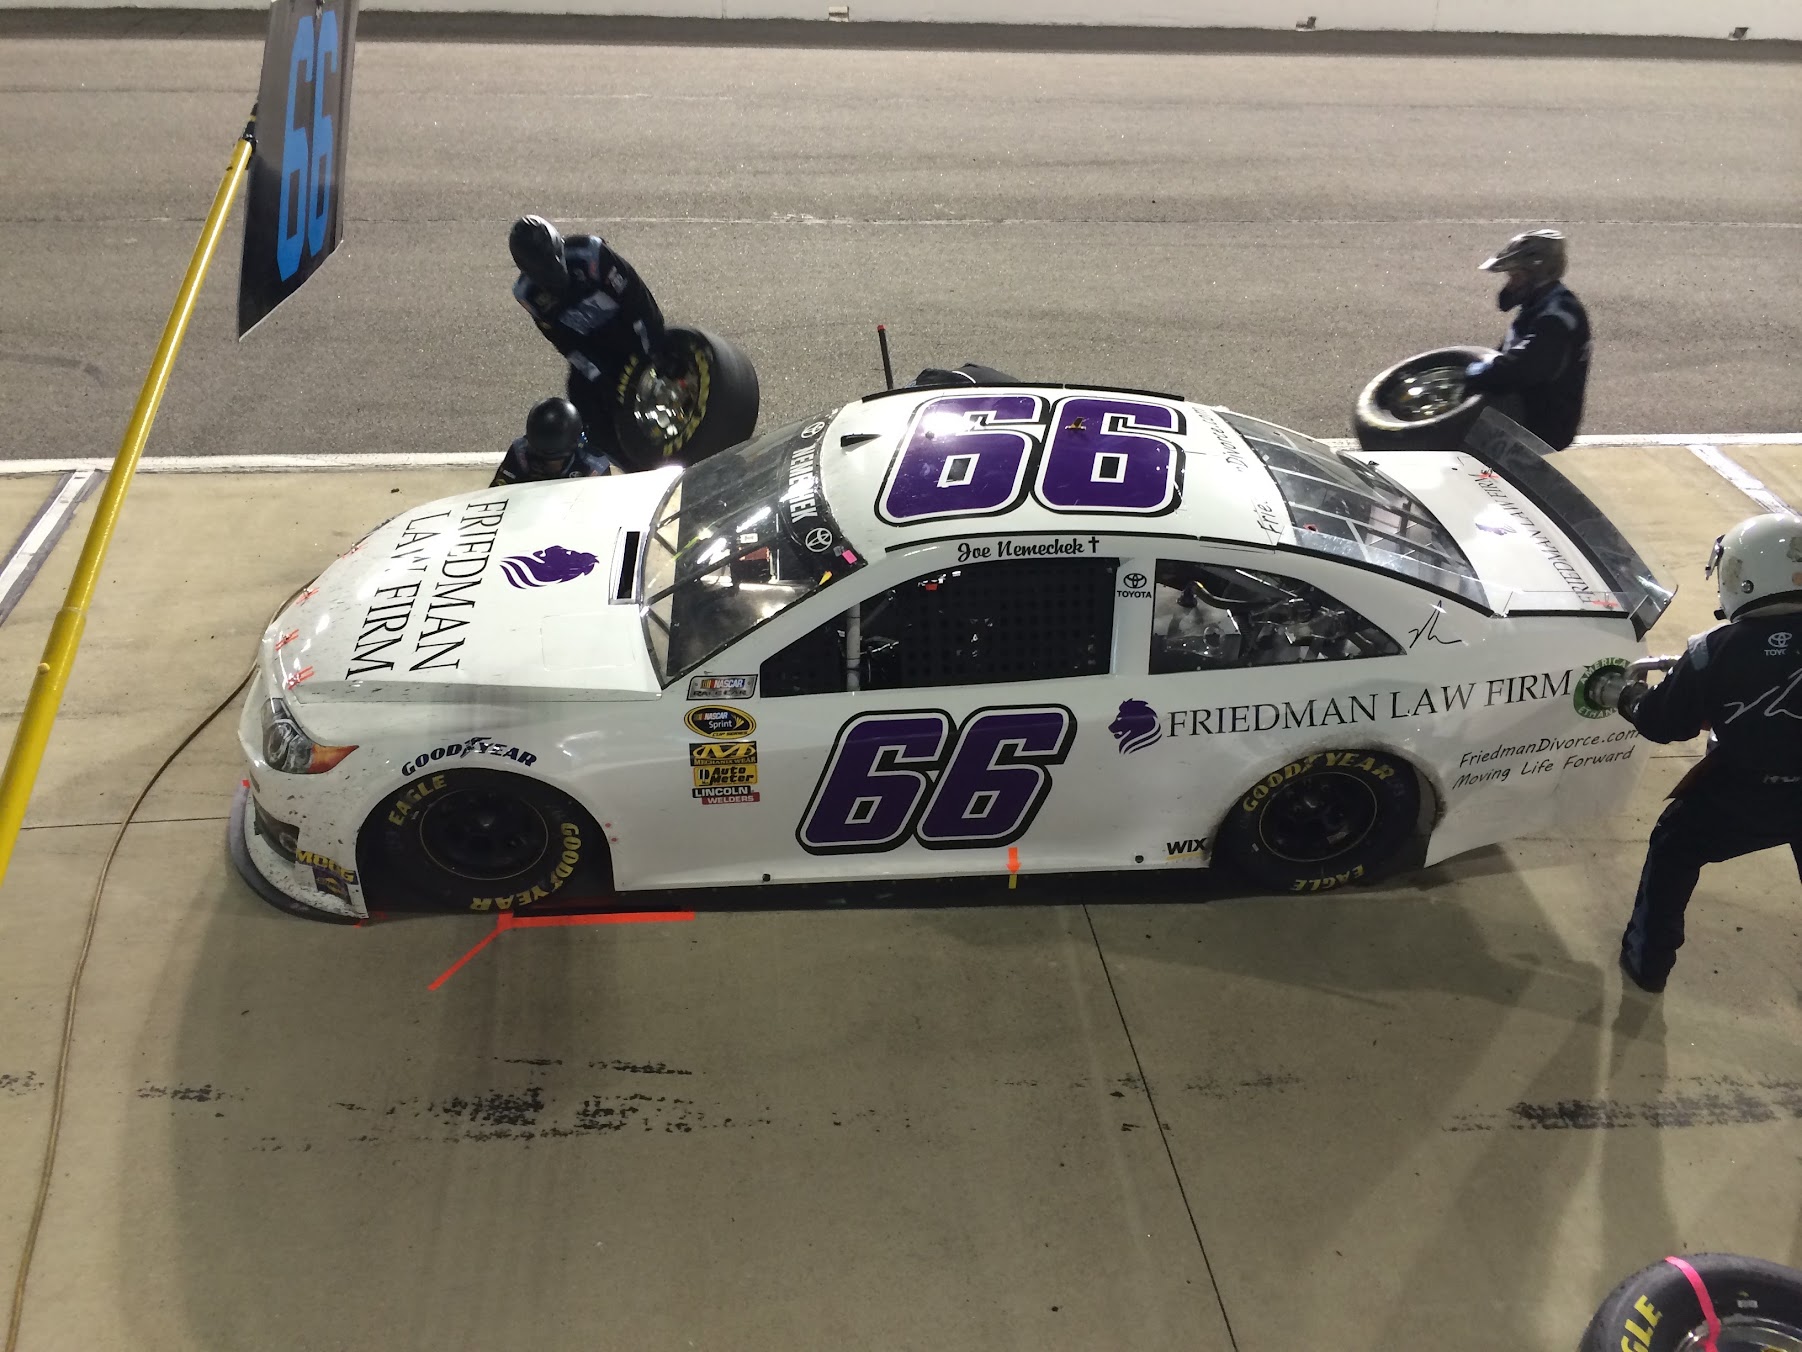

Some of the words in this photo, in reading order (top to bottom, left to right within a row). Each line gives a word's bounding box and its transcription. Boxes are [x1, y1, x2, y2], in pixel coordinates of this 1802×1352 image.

[277, 10, 339, 283] 66
[874, 393, 1187, 528] 66
[788, 443, 818, 524] NEMEHEK
[957, 541, 992, 562] Joe
[998, 537, 1085, 557] Nemechek
[409, 499, 509, 671] FRIEDMAN
[1116, 590, 1152, 599] TOYOTA
[346, 580, 421, 680] FIRM
[713, 679, 744, 689] NASCAR
[1580, 657, 1628, 684] AMERICA
[704, 712, 729, 720] NASCAR
[1166, 693, 1379, 737] FRIEDMAN
[1390, 683, 1477, 719] LAW
[1483, 669, 1574, 707] FIRM
[1578, 706, 1619, 718] ETHAN
[708, 720, 732, 730] Sprint
[1459, 729, 1640, 769] FriedmanDivorce.com
[712, 766, 747, 776] Auto
[795, 703, 1078, 856] 66
[1452, 766, 1511, 790] Moving
[1520, 759, 1554, 775] Life
[1563, 745, 1636, 770] Forward
[388, 774, 448, 828] EAGLE
[694, 786, 749, 797] LINCOLN
[707, 795, 755, 804] WELDERS
[1166, 838, 1208, 855] WIX
[1289, 864, 1364, 891] EAGLE
